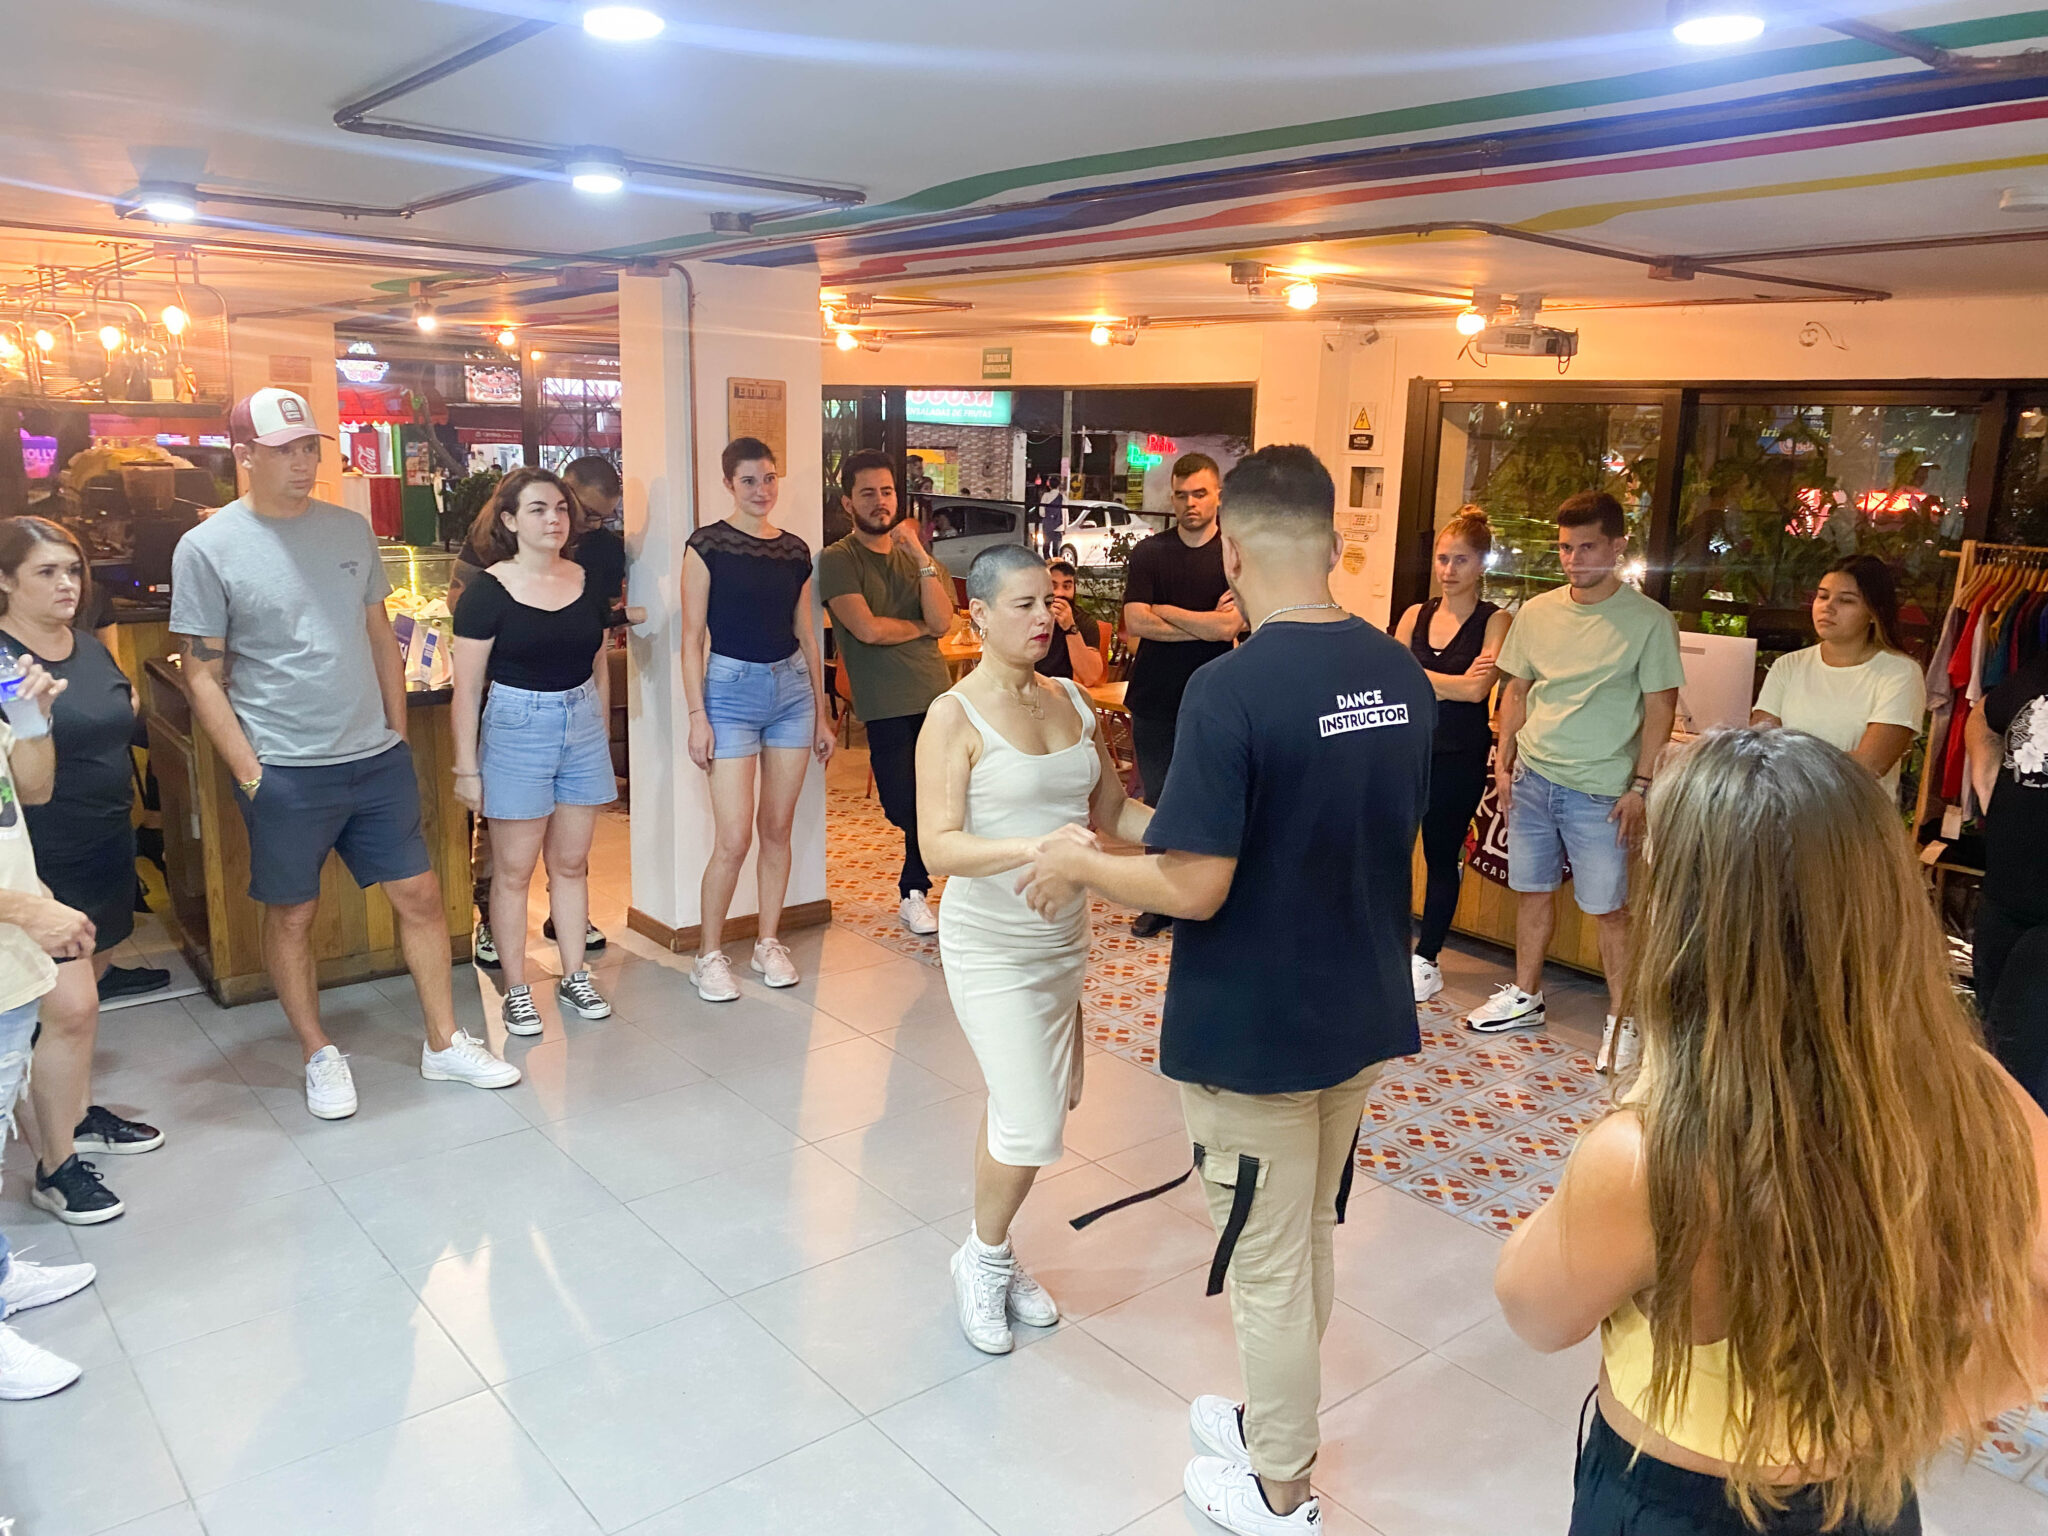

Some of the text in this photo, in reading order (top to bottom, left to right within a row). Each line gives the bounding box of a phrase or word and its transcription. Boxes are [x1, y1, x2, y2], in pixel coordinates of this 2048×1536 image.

[1336, 689, 1384, 710] DANCE
[1321, 705, 1408, 735] INSTRUCTOR
[1472, 856, 1509, 880] ACAD
